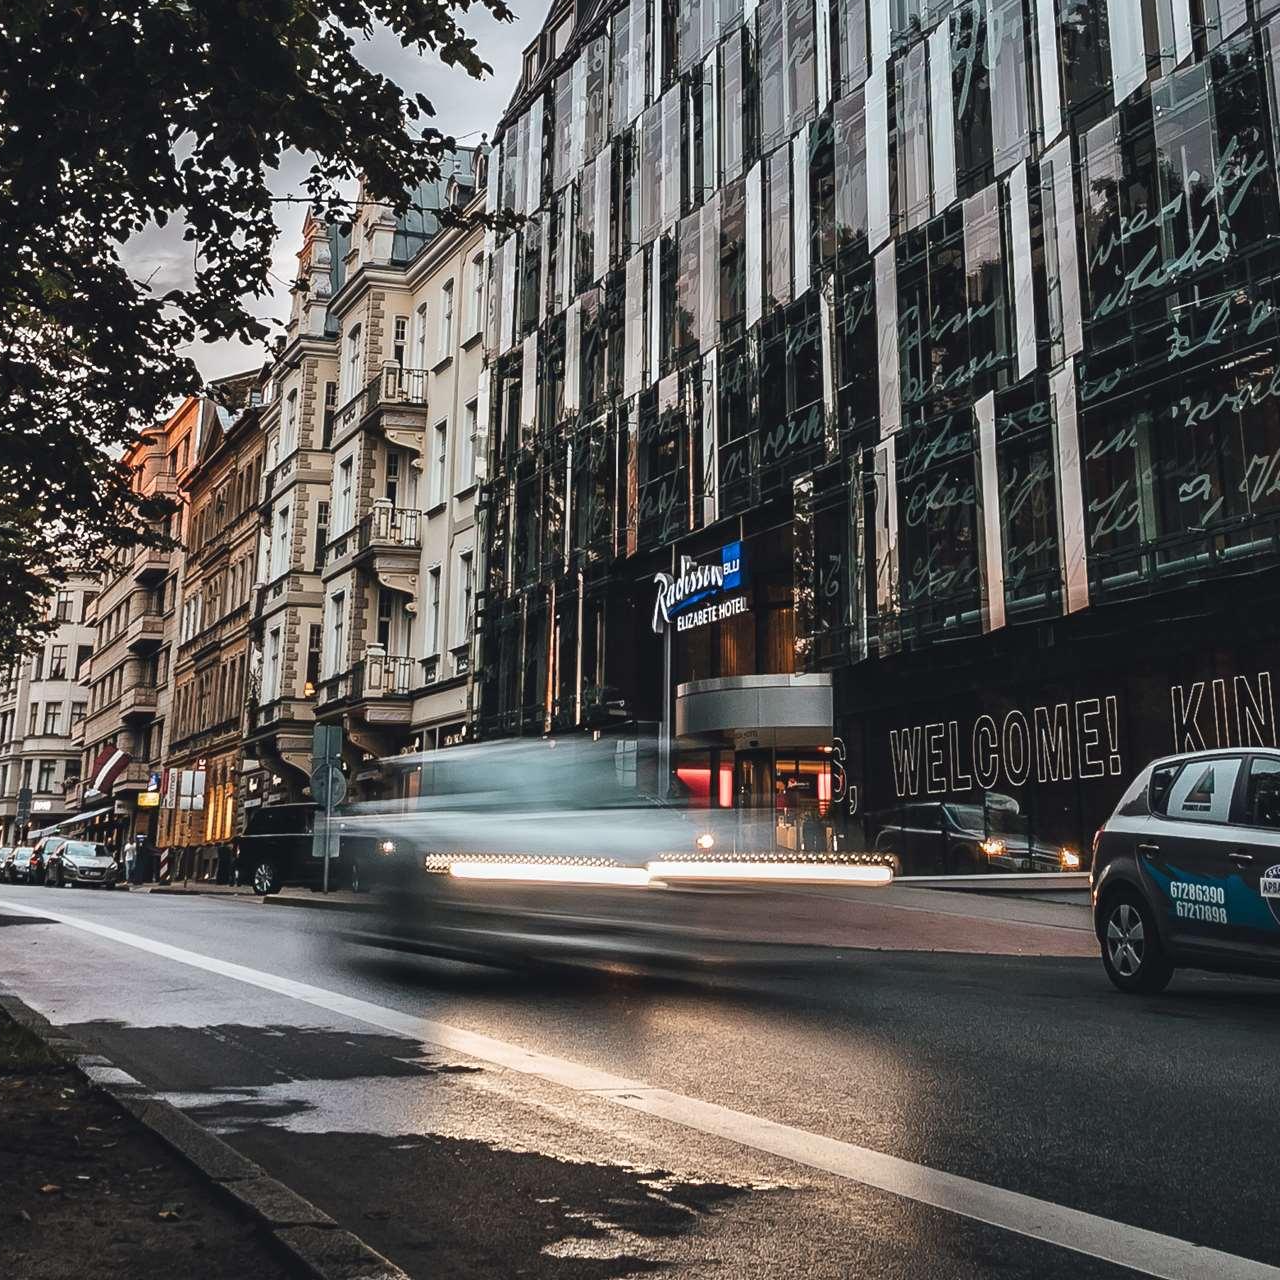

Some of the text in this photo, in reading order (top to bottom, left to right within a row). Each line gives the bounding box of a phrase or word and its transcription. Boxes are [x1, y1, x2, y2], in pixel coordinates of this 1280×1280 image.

[652, 554, 740, 632] Radisson BLU
[677, 596, 748, 632] ELIZABETE HOTEL
[889, 695, 1122, 797] WELCOME!
[1170, 881, 1225, 904] 67286390
[1176, 900, 1228, 925] 67217898
